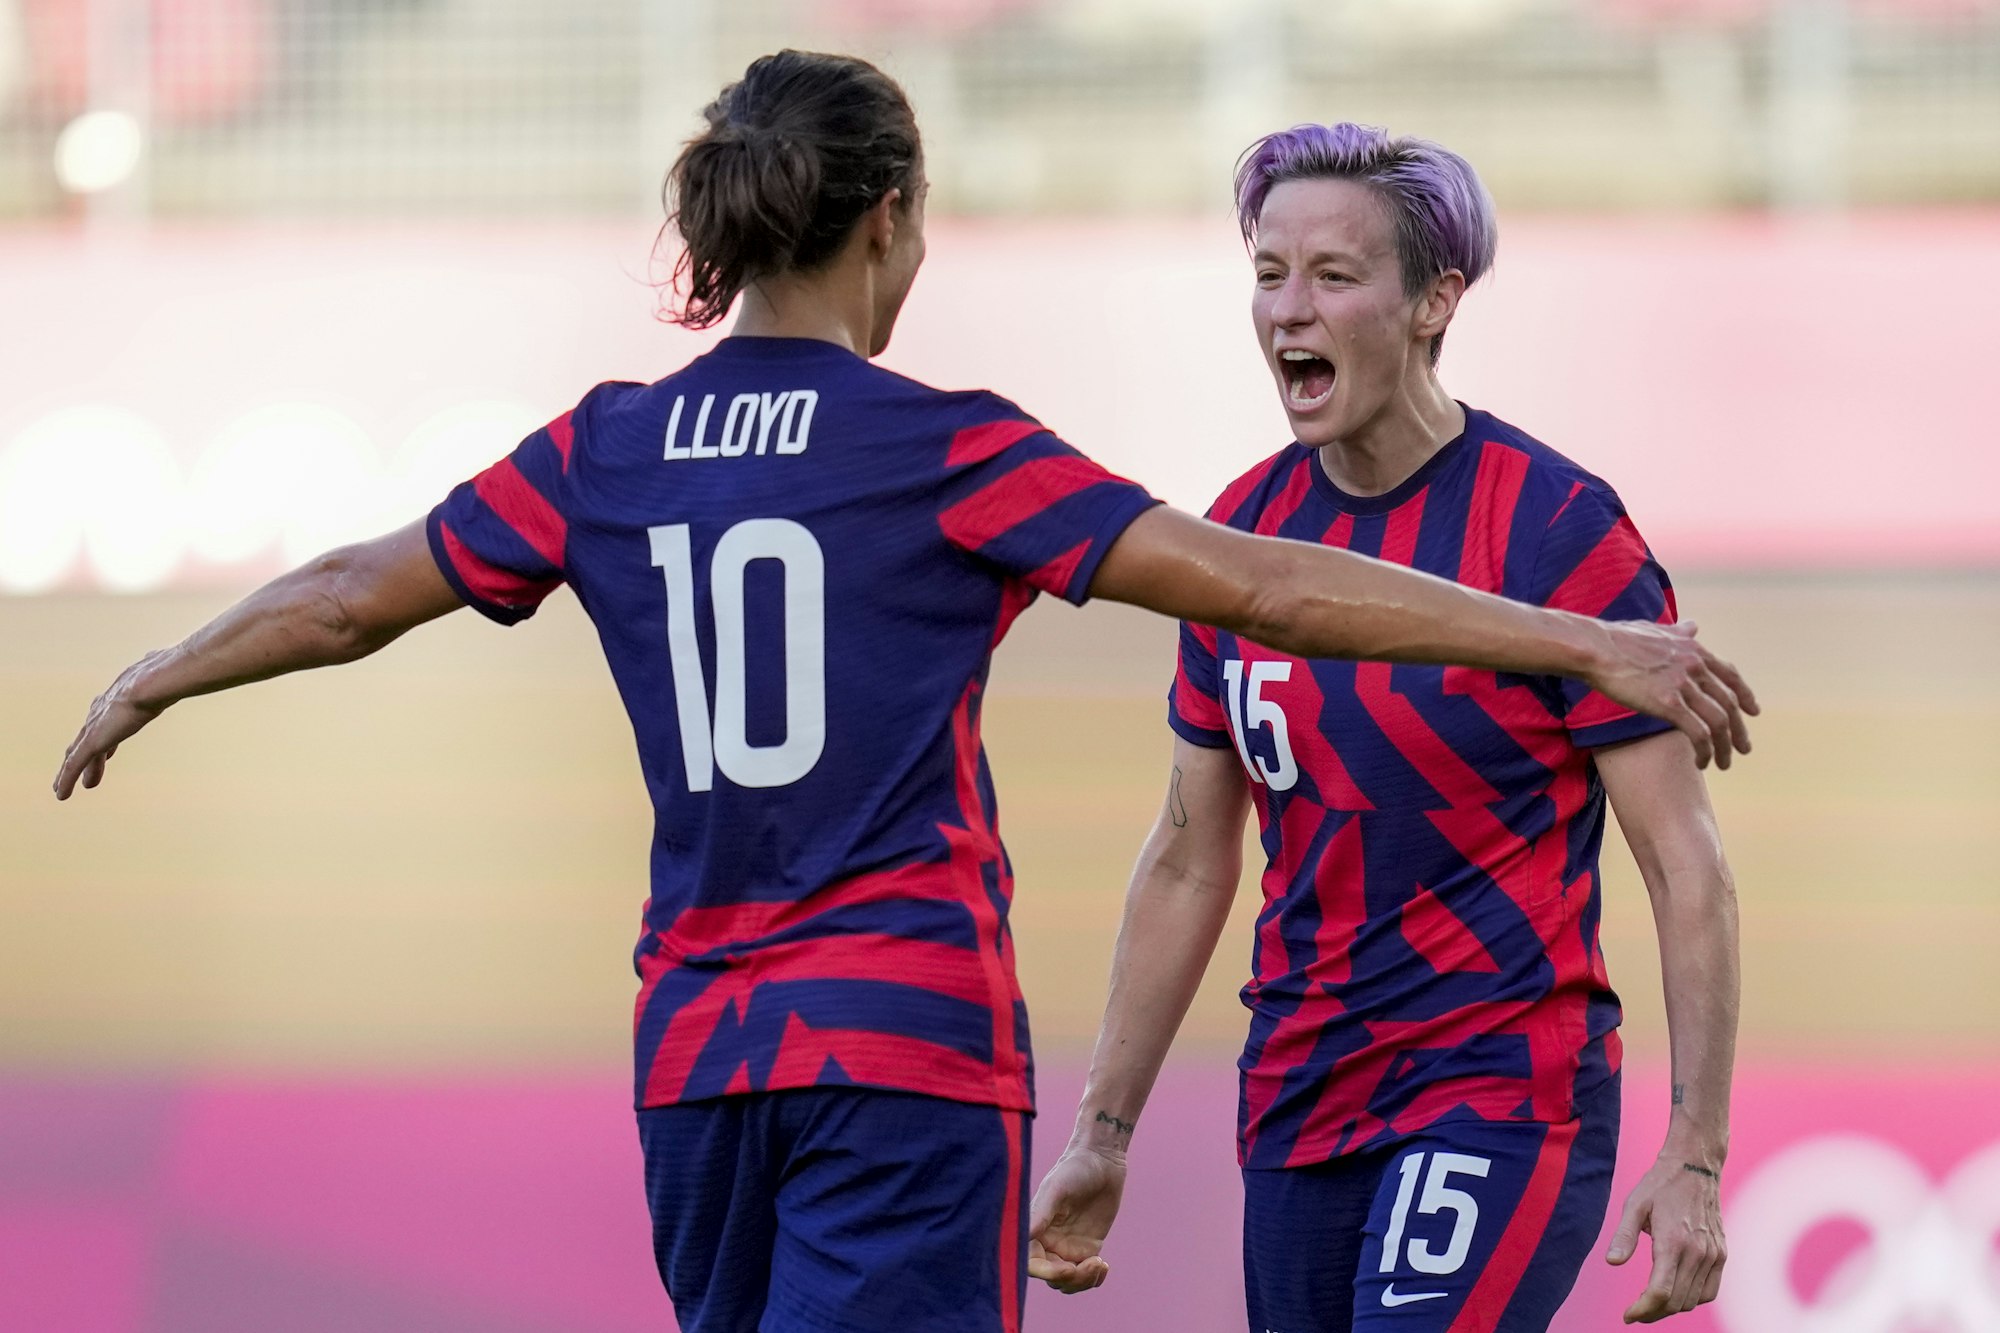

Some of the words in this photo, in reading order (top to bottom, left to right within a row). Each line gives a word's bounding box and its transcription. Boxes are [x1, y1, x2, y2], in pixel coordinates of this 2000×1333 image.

[664, 390, 818, 461] LLOYD
[648, 518, 826, 792] 10
[1222, 659, 1299, 792] 15
[1379, 1152, 1491, 1275] 15
